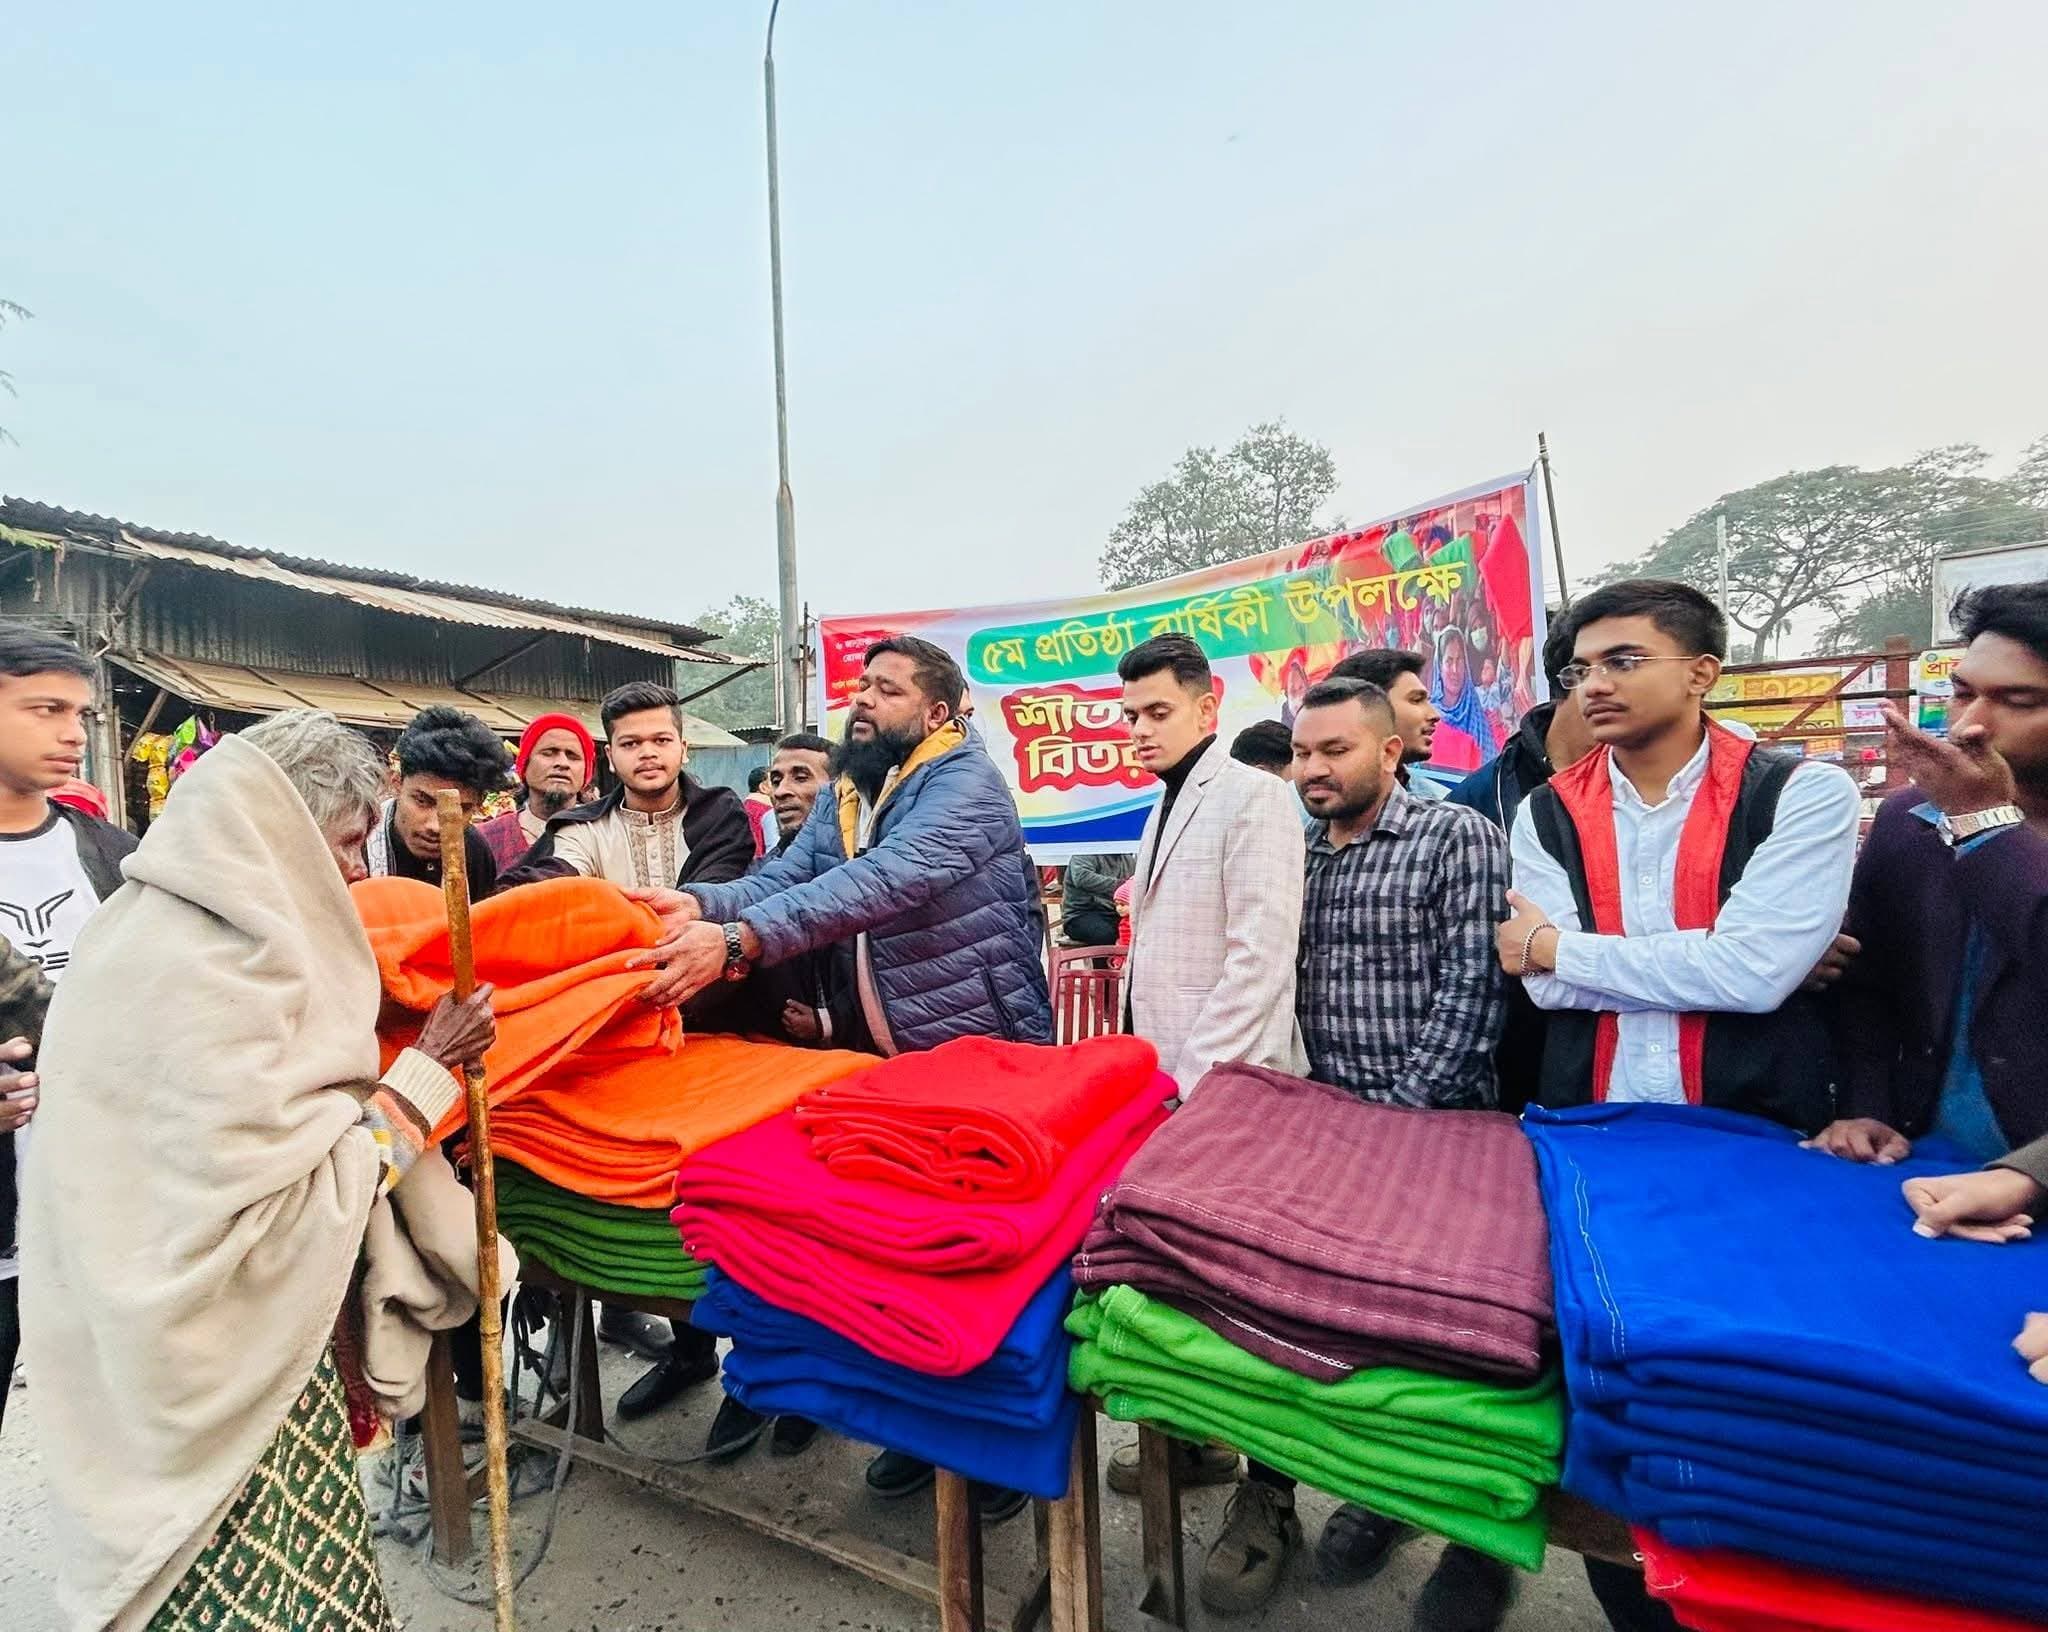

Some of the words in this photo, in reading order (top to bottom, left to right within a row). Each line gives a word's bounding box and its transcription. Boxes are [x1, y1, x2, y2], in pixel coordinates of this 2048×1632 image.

[982, 638, 1027, 674] ৫ম
[1035, 612, 1136, 666] প্রতিষ্ঠা
[1283, 561, 1468, 624] উপলক্ষে
[1010, 693, 1131, 736] শীত
[1025, 734, 1146, 781] বিতর
